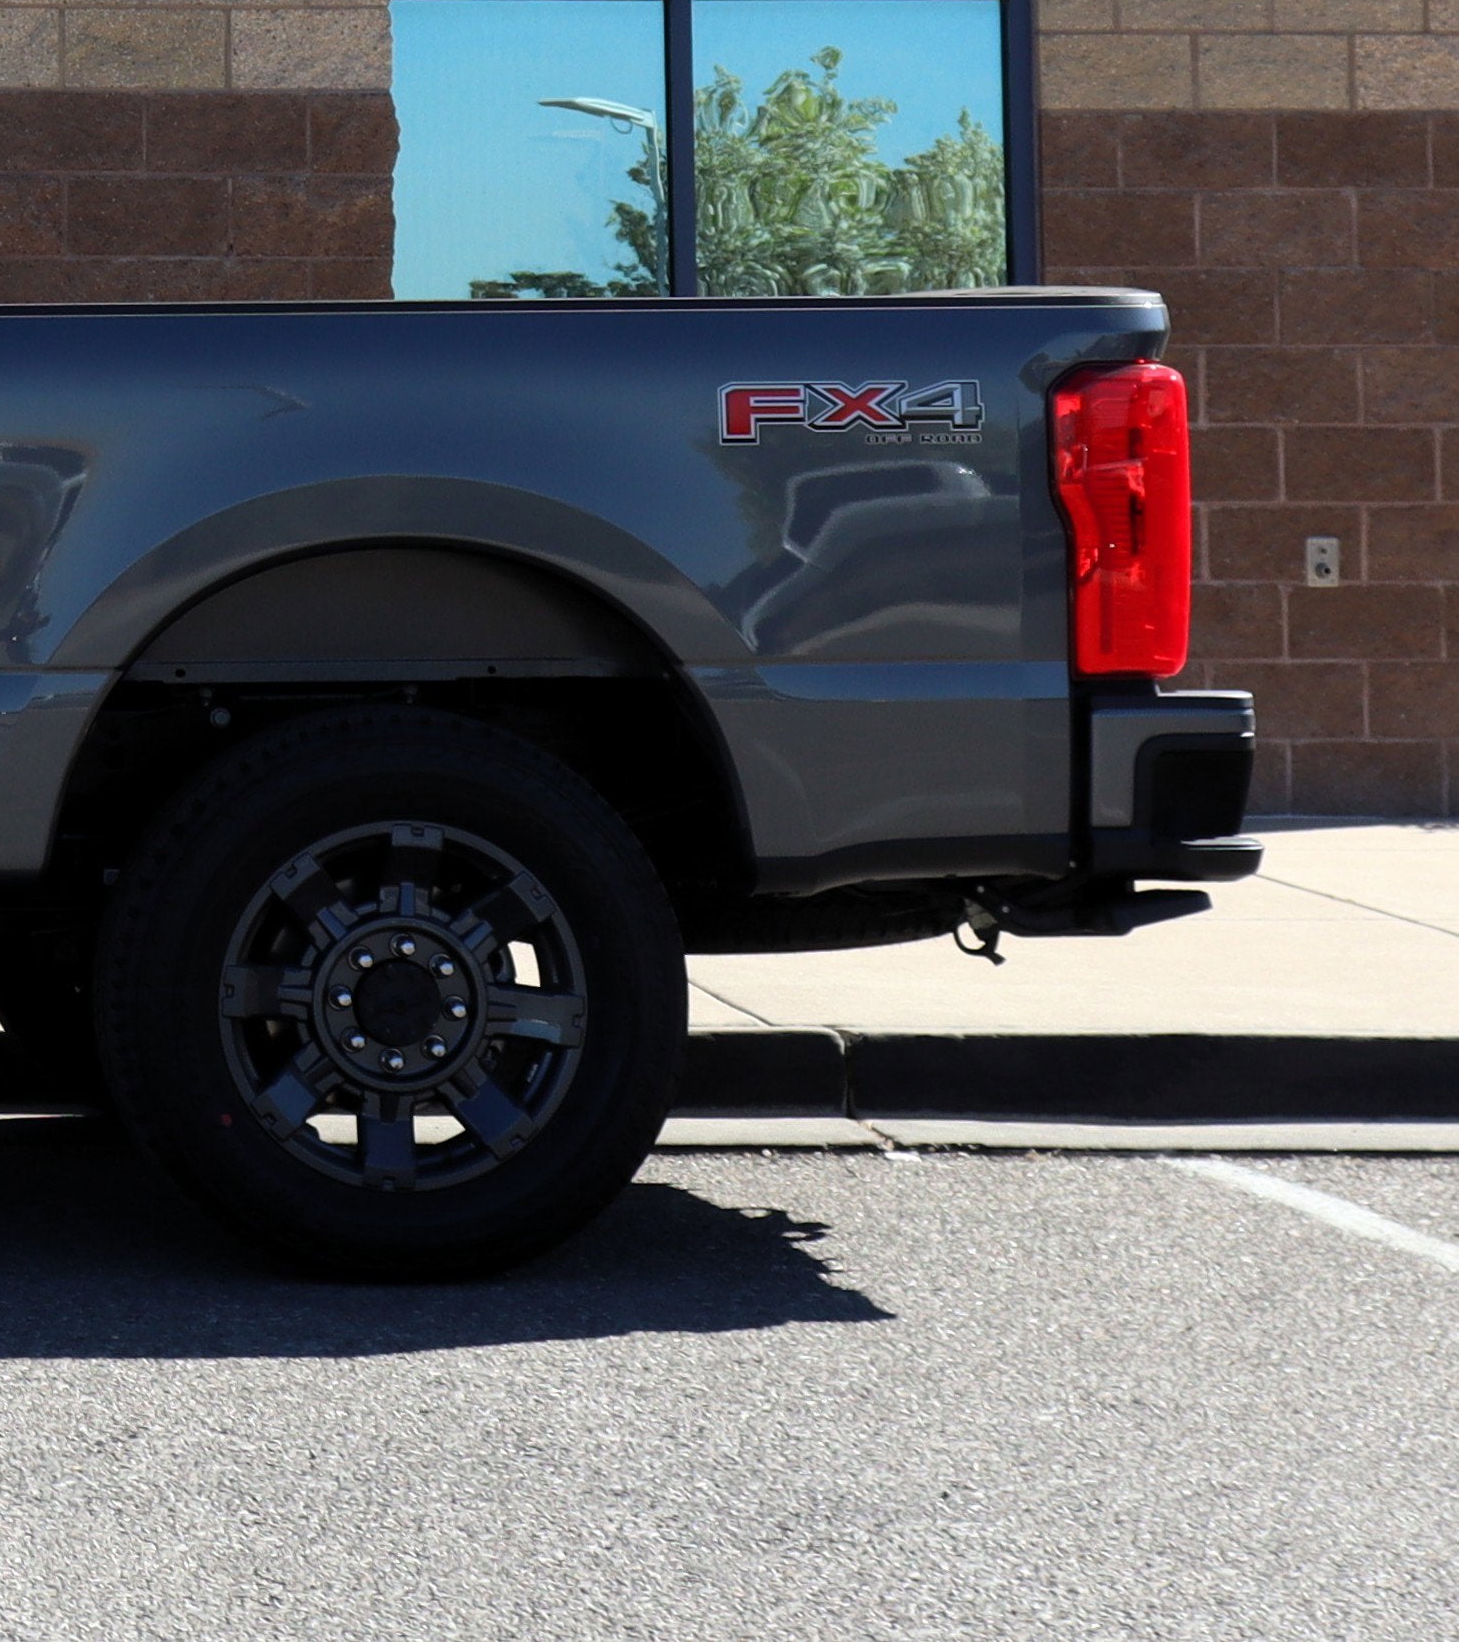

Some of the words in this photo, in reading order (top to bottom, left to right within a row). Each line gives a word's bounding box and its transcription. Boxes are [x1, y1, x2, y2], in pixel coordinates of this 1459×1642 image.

[717, 380, 984, 445] FX4
[865, 433, 912, 445] OFF
[919, 433, 982, 445] ROAD
